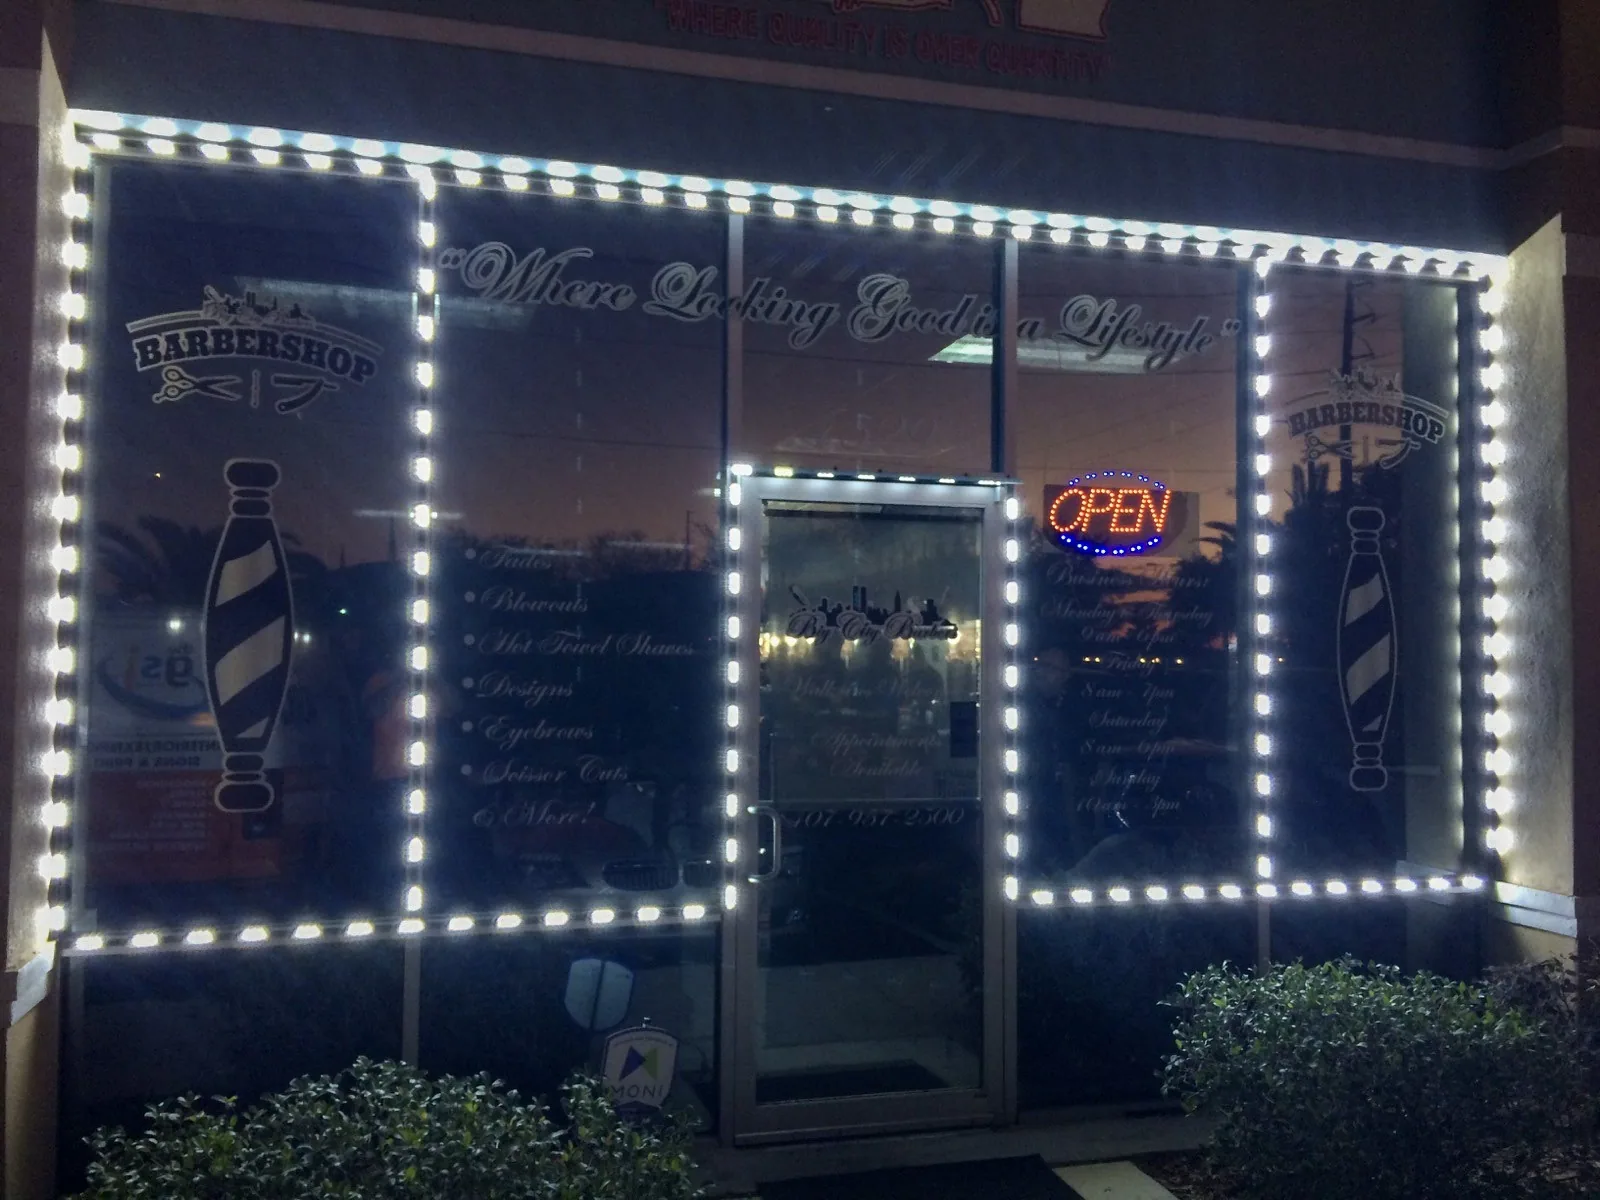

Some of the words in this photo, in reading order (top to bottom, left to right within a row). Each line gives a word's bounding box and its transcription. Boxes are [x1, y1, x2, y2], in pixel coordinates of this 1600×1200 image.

[767, 11, 877, 57] QUALITY
[884, 23, 910, 59] IS
[915, 27, 981, 71] OVER
[643, 260, 841, 350] Looking
[847, 273, 980, 343] Good
[1015, 316, 1045, 339] a
[132, 326, 379, 386] BARBERSHOP
[1287, 399, 1446, 444] BARBERSHOP
[1050, 487, 1172, 533] OPEN
[480, 585, 589, 613] Blowouts
[478, 628, 533, 655] Hot
[537, 629, 613, 655] Towel
[615, 632, 697, 656] Shaves
[786, 611, 832, 646] Big
[836, 609, 884, 643] City
[479, 671, 573, 708] Designs
[478, 715, 596, 751] Eyebrows
[1088, 707, 1168, 734] Saturday
[482, 759, 567, 785] Scissor
[576, 753, 629, 783] Cuts
[503, 801, 597, 828] More!
[610, 1084, 665, 1099] MONI
